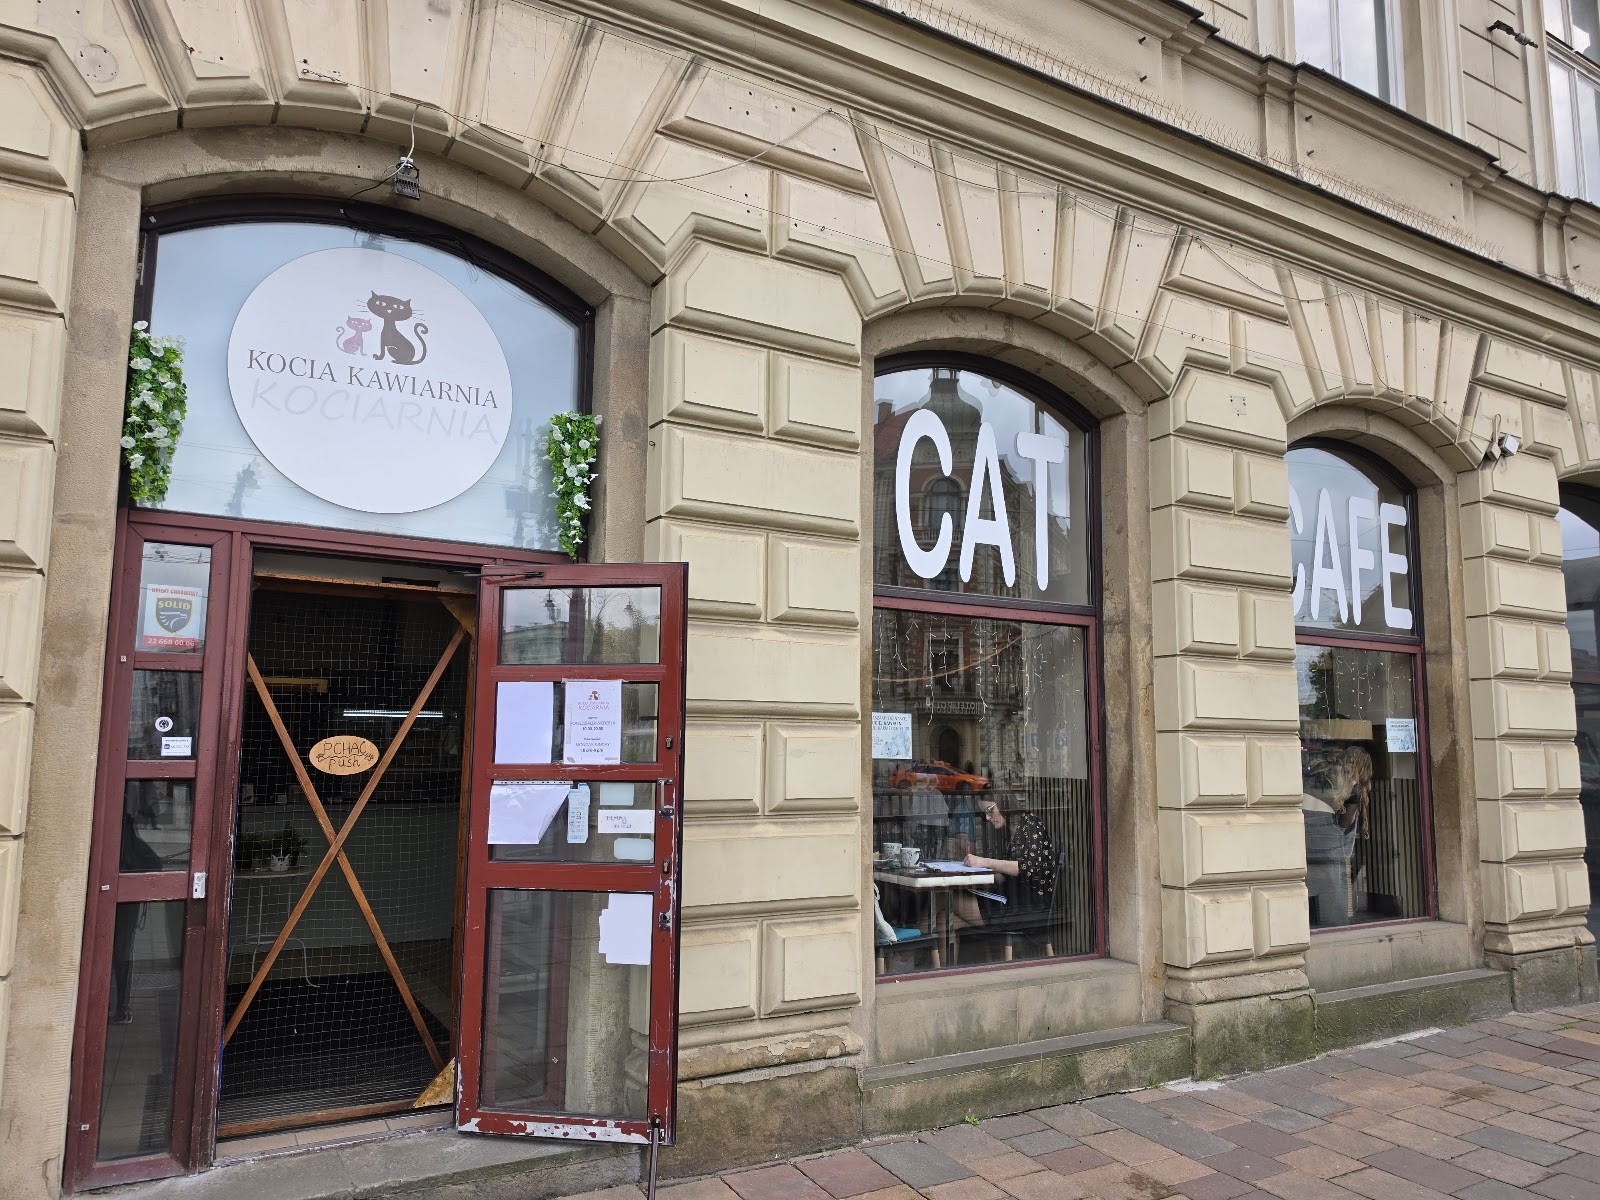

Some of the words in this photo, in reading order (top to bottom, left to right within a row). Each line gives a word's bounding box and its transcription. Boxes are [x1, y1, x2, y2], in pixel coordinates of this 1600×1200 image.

[247, 348, 337, 382] KOCIA
[347, 365, 498, 409] KAWIARNIA
[250, 377, 498, 445] KOCIARNIA
[895, 408, 1065, 591] CAT
[158, 600, 191, 610] SOLID
[147, 637, 158, 645] 22
